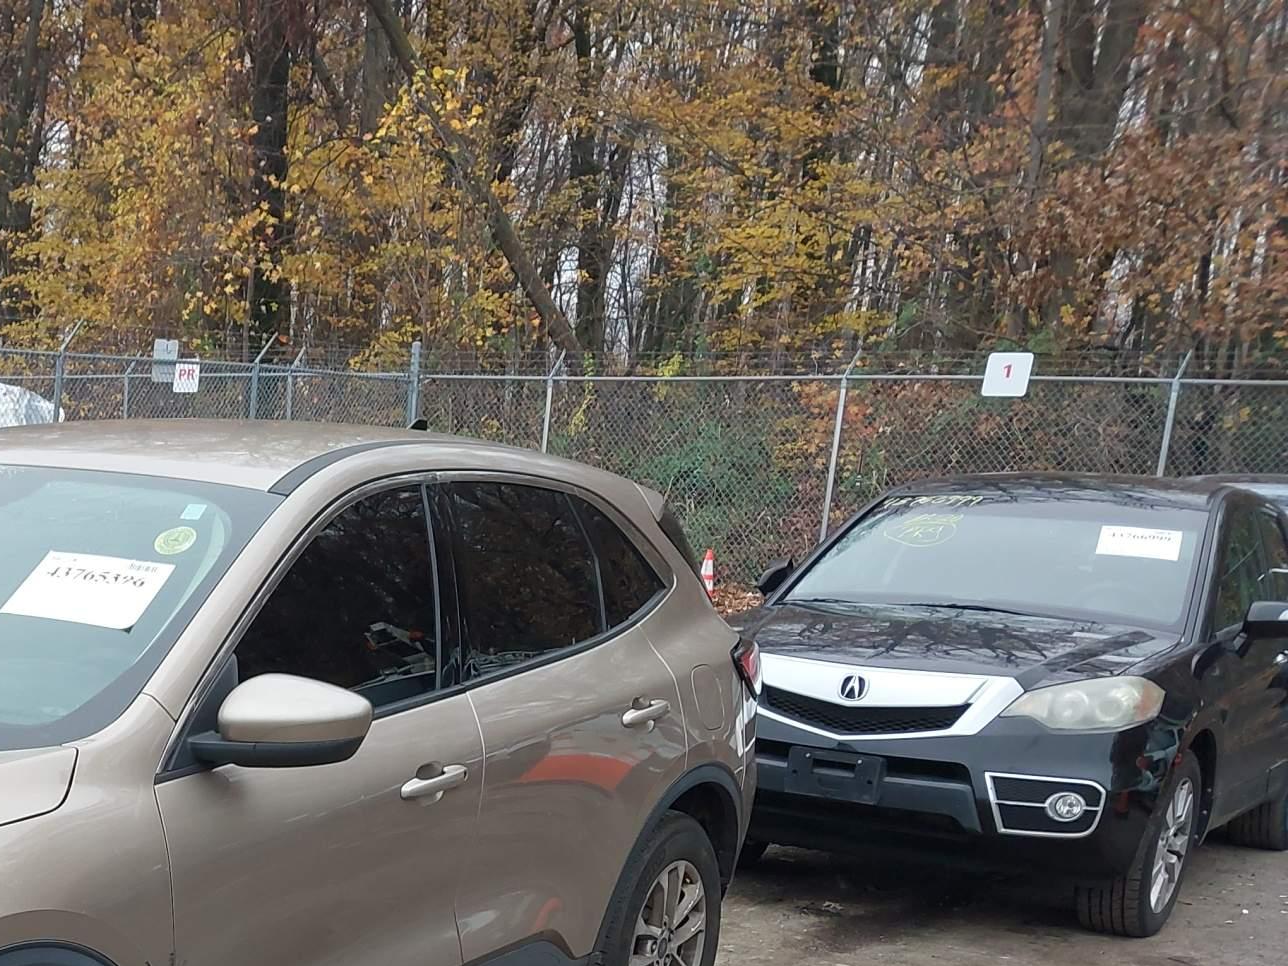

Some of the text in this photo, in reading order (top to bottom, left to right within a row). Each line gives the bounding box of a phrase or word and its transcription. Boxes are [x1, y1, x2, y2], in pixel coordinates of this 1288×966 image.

[178, 368, 196, 381] PR
[1003, 364, 1012, 378] 1
[47, 566, 146, 588] 43765396
